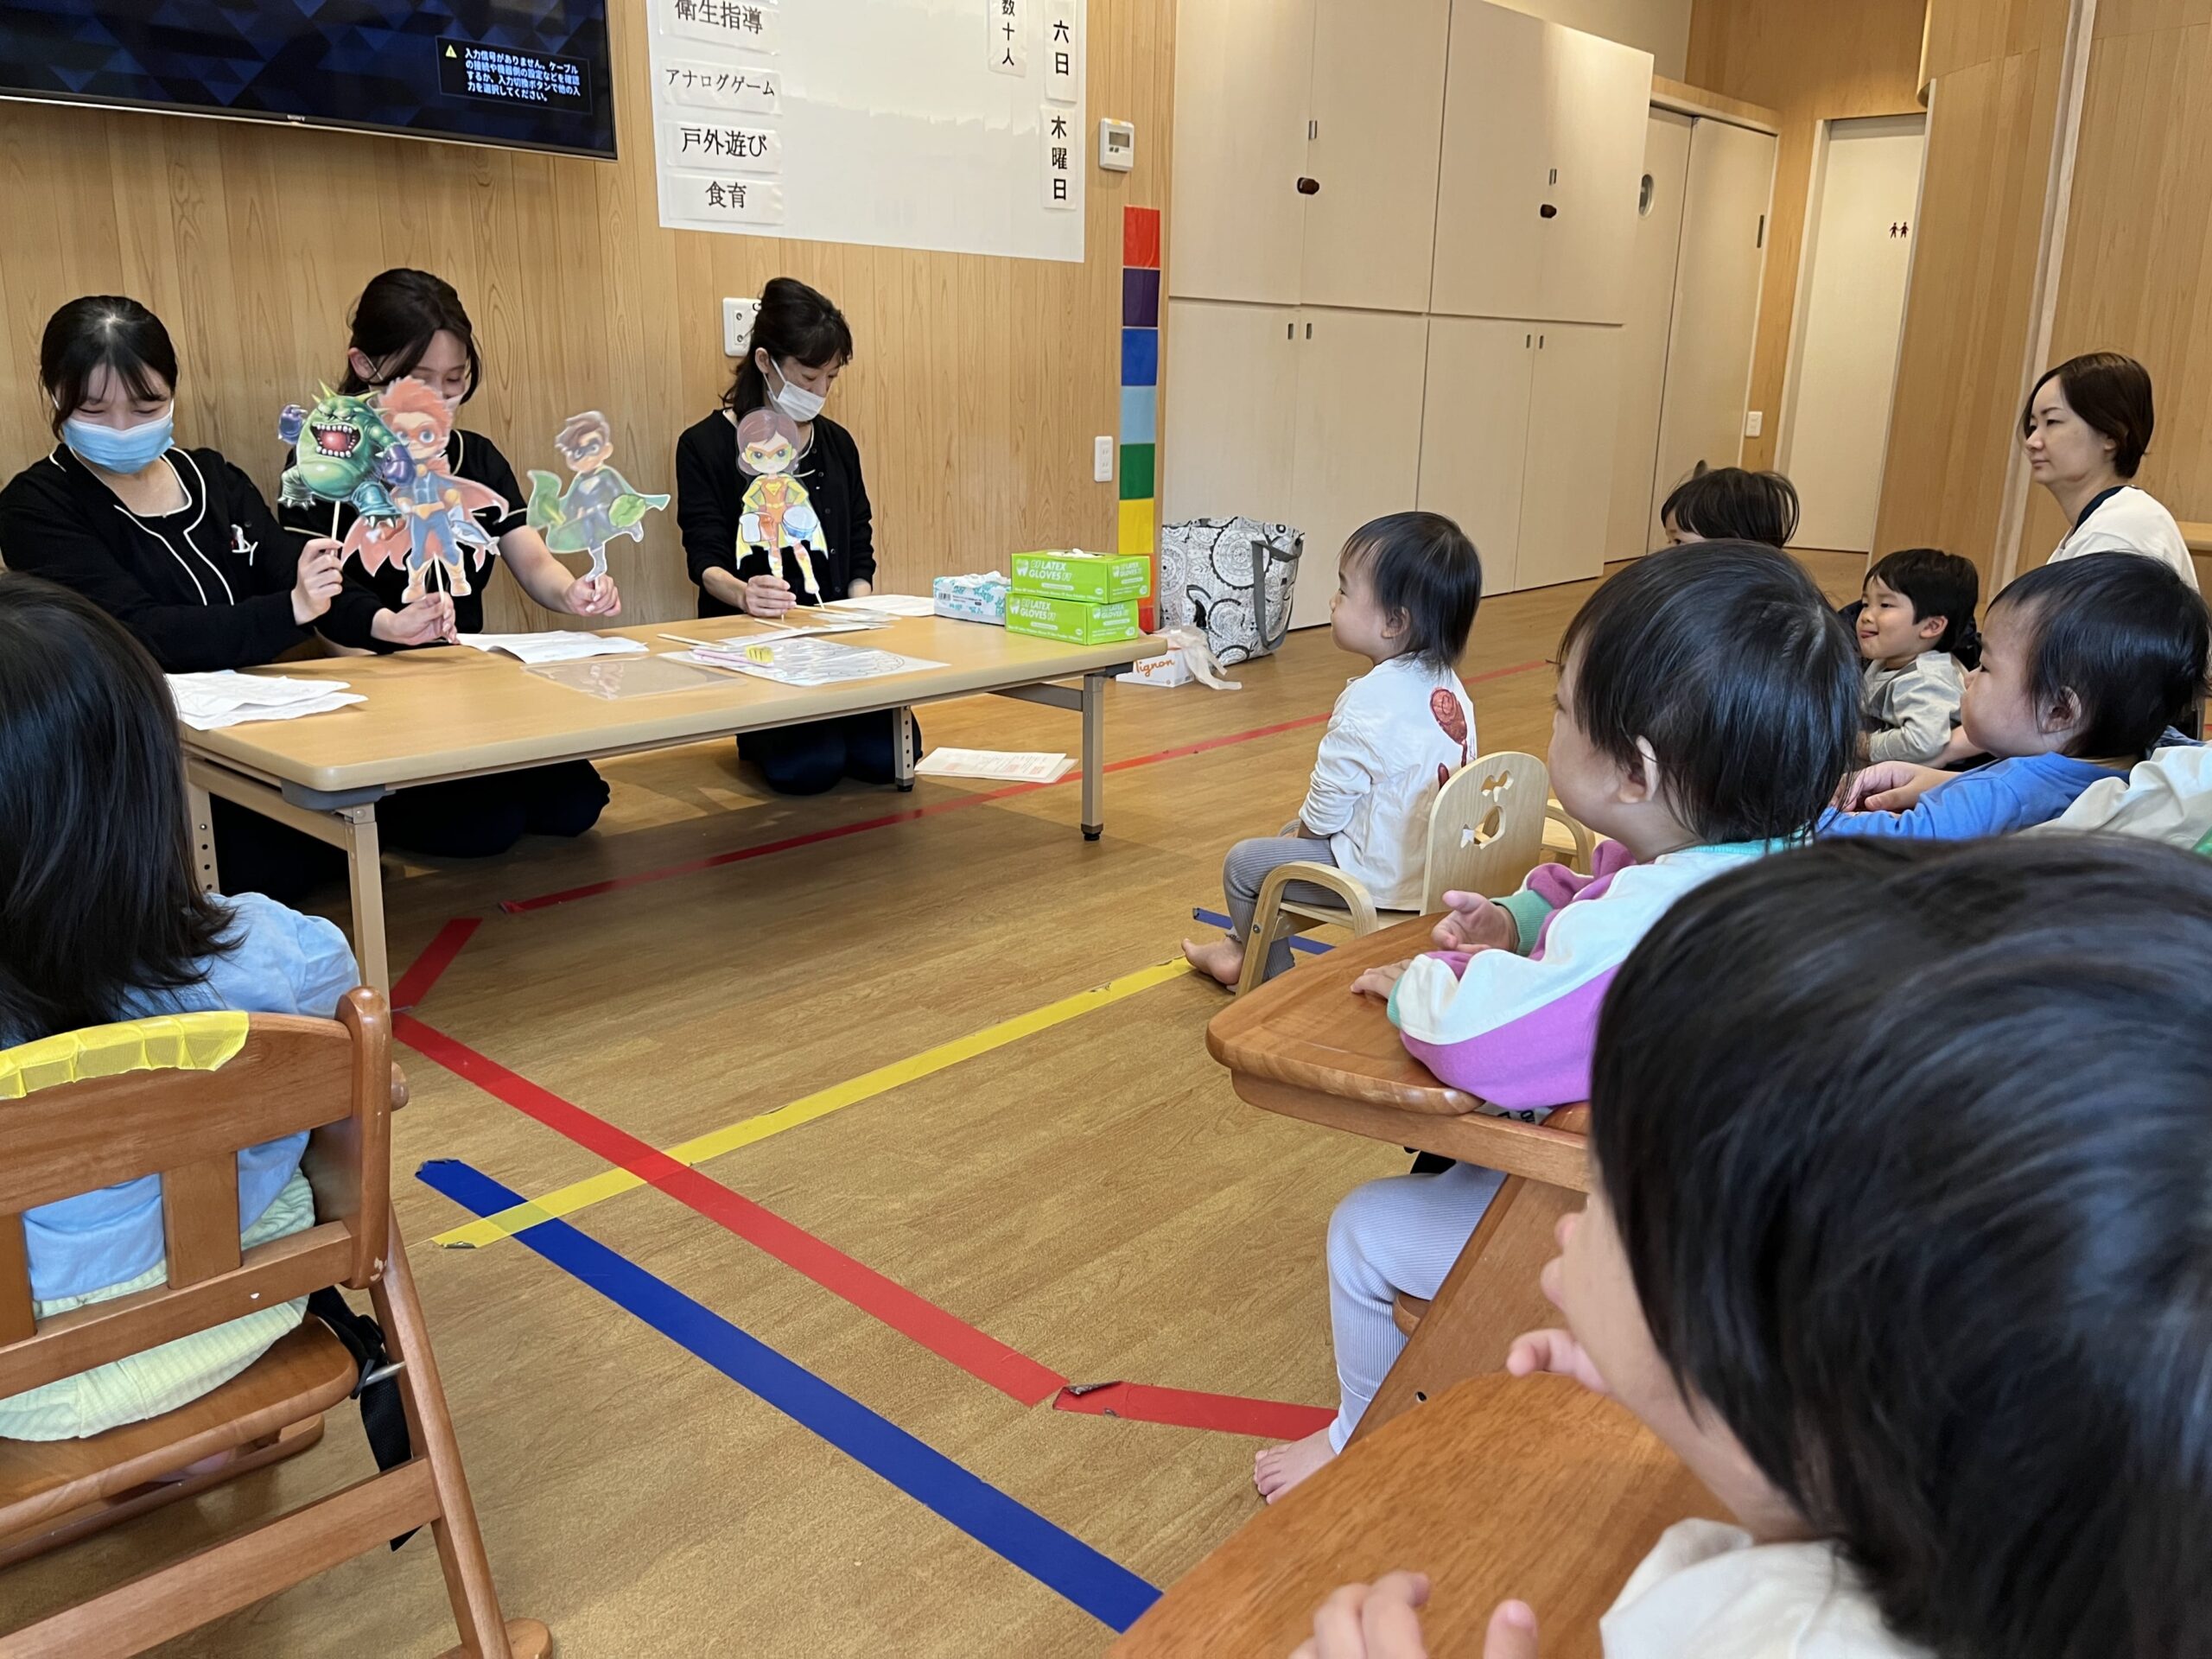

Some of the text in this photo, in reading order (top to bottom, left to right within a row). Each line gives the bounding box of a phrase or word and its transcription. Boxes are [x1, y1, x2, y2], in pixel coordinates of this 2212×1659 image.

[675, 0, 763, 35] 衛生指導
[1053, 19, 1070, 76] 六日
[665, 68, 775, 97] アナログゲーム
[680, 127, 767, 157] 戸外遊び
[1051, 115, 1068, 201] 木曜日
[705, 181, 747, 209] 食育
[1028, 569, 1062, 582] GLOVES
[1041, 561, 1066, 572] LATEX
[1020, 607, 1048, 620] GLOVES
[1031, 600, 1052, 611] LATEX
